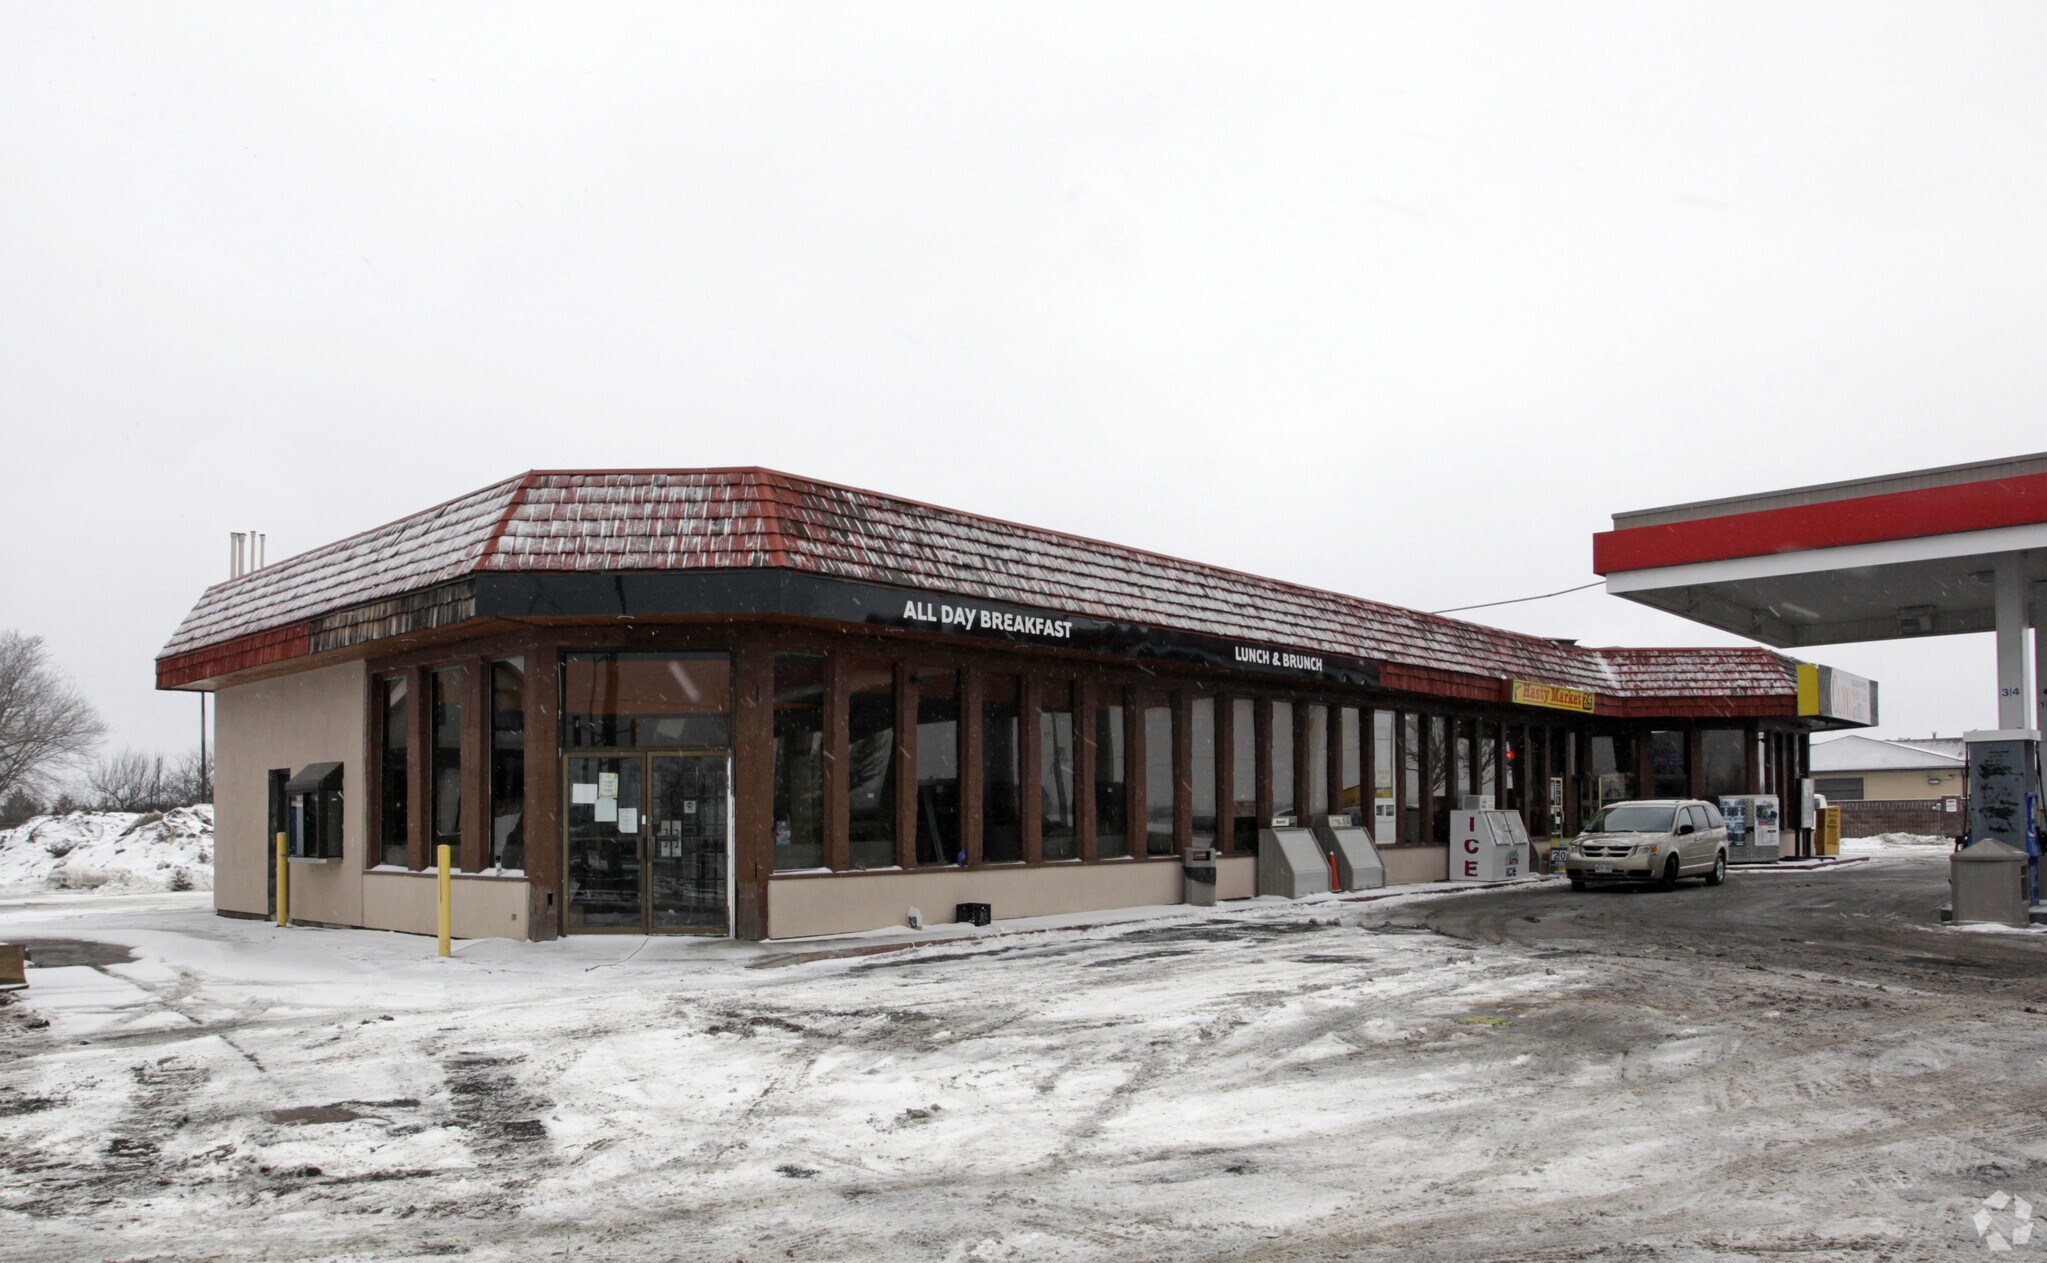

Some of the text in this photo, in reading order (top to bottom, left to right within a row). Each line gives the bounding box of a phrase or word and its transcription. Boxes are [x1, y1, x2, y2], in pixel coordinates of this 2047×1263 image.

[903, 601, 1072, 638] ALL DAY BREAKFAST
[1235, 647, 1322, 671] LUNCH & BRUNCH
[1522, 683, 1581, 705] Hasty Market
[1464, 816, 1479, 877] ICE
[1506, 867, 1516, 877] ICE
